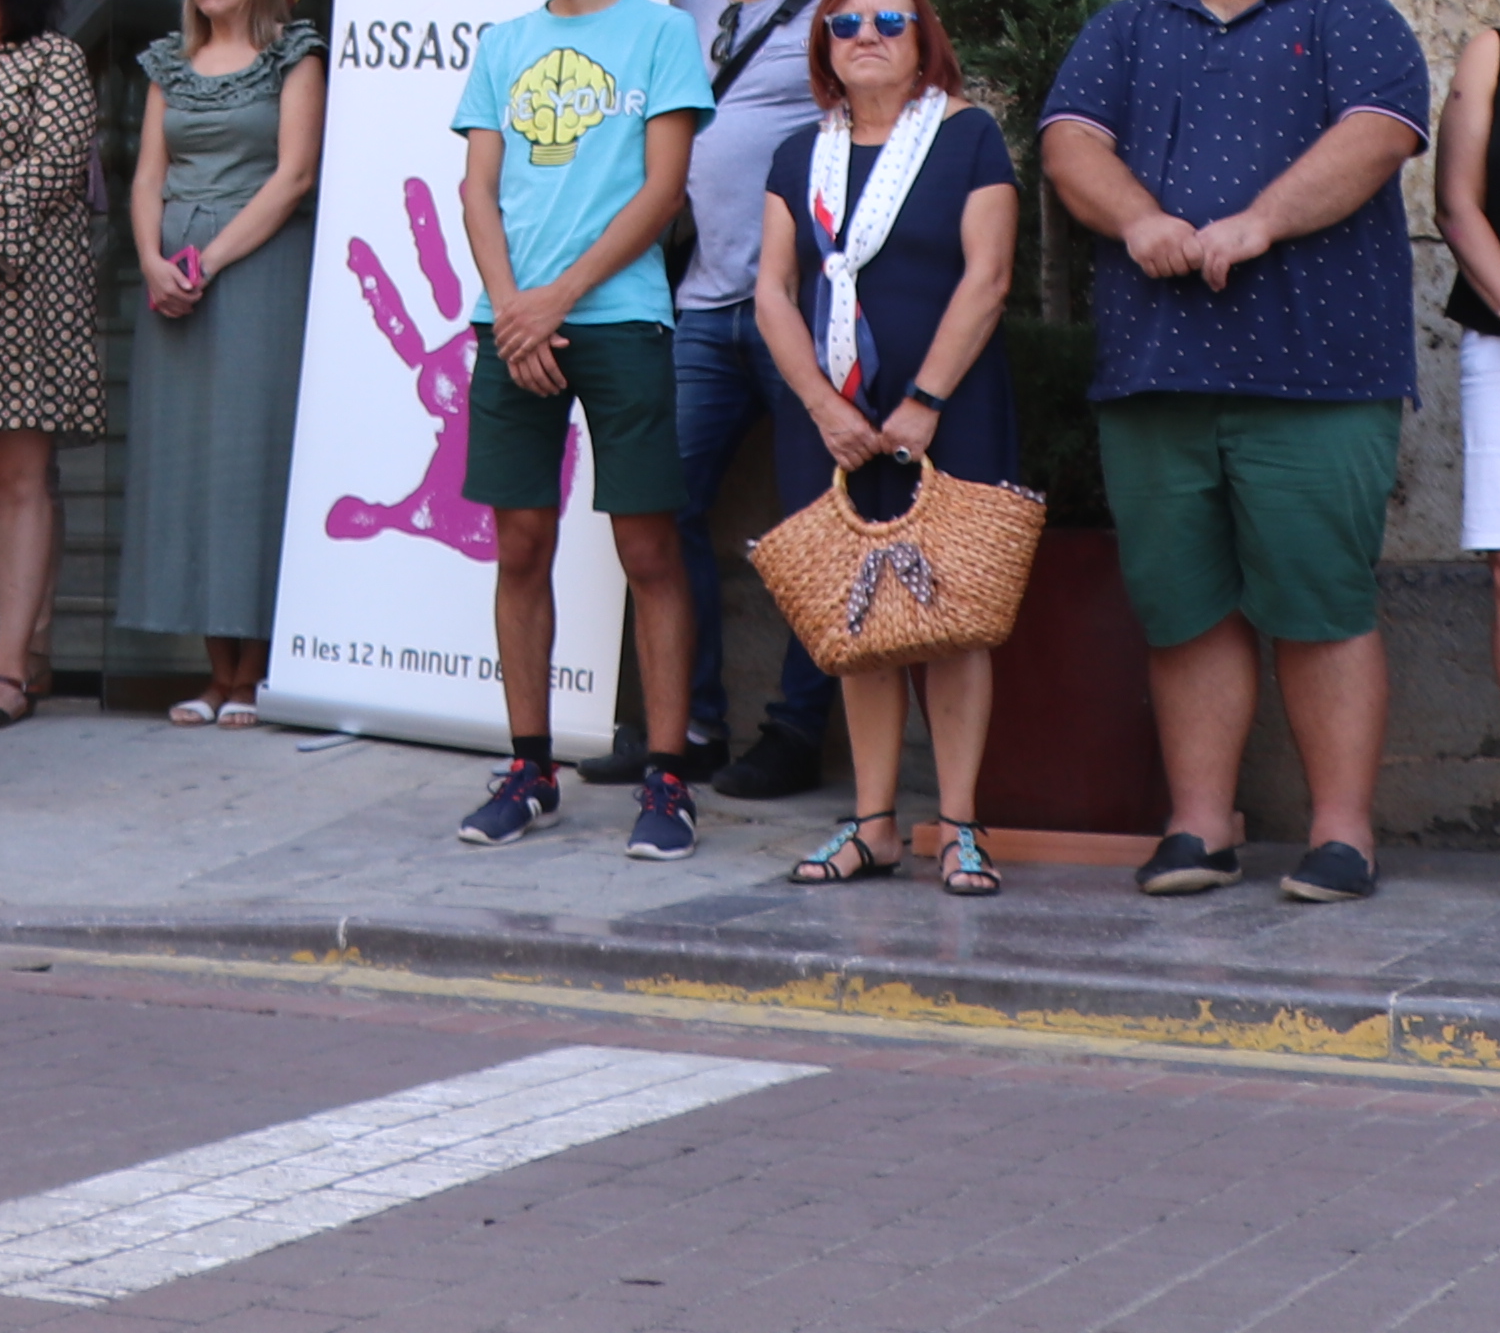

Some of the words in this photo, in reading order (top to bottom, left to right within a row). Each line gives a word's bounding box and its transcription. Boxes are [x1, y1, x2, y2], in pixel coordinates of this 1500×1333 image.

[548, 86, 647, 118] YOUR
[292, 634, 307, 658] A
[312, 636, 341, 661] les
[348, 642, 375, 667] 12
[381, 645, 393, 669] h
[400, 648, 474, 679] MINUT
